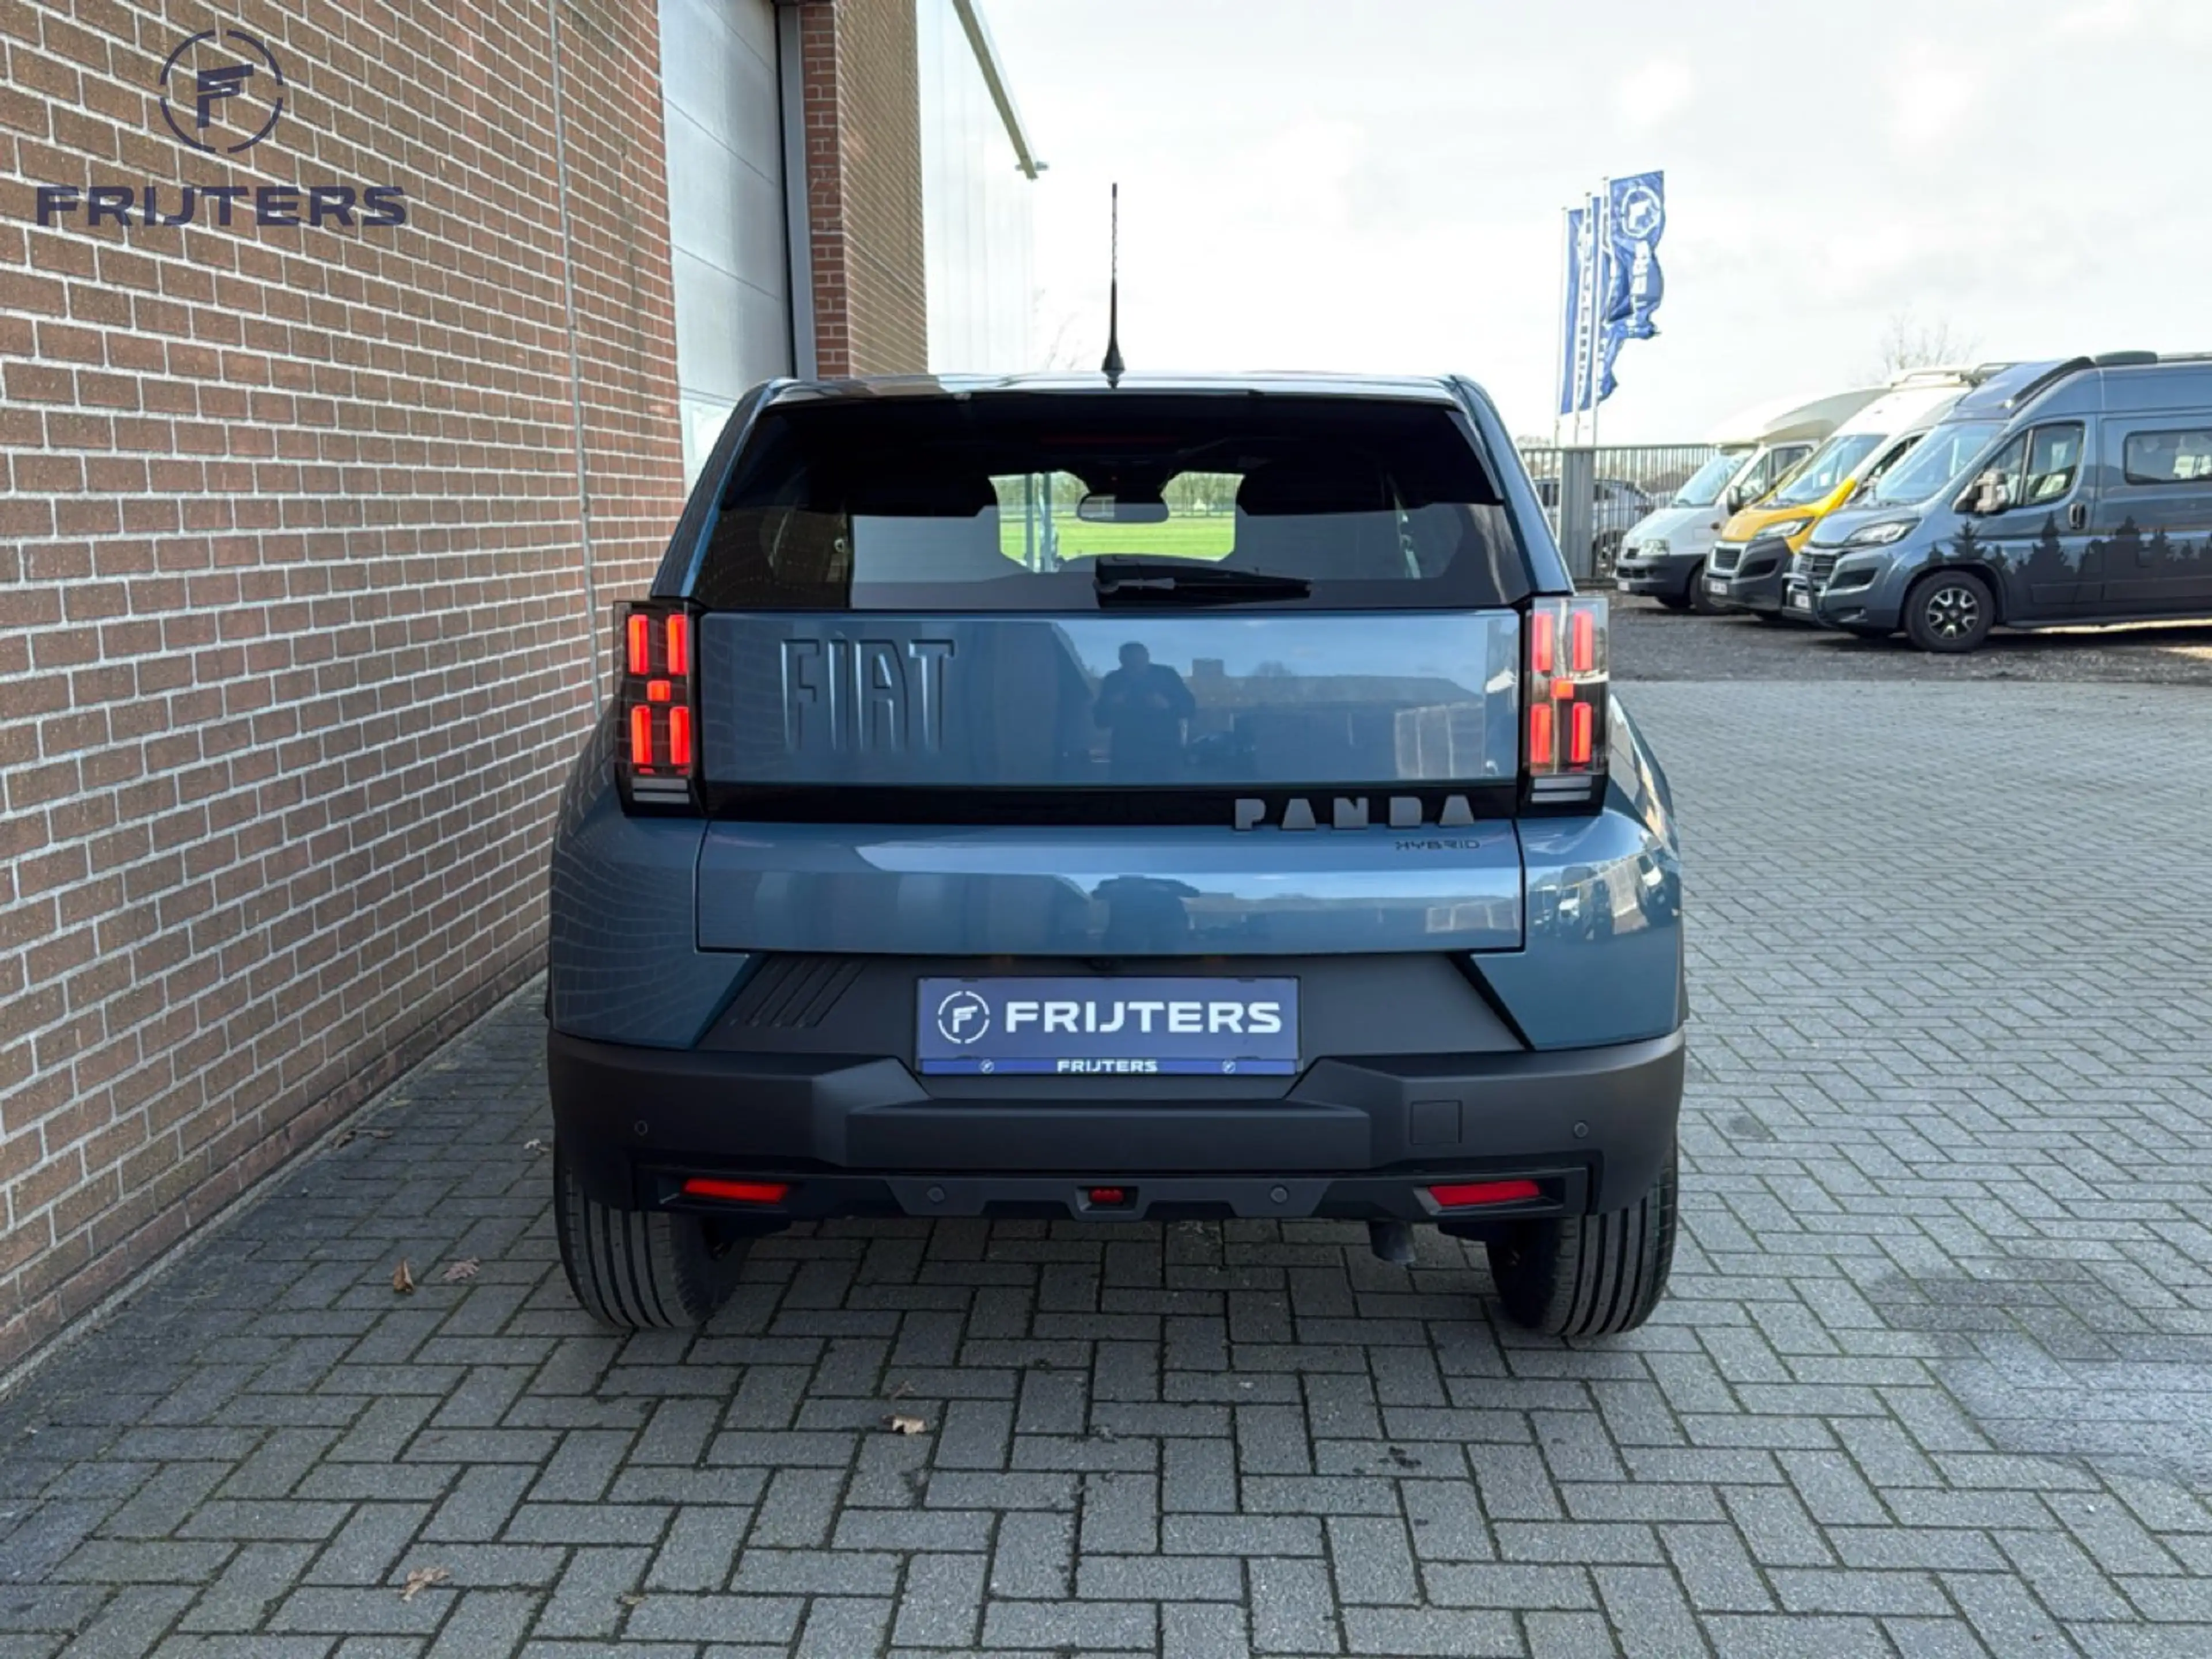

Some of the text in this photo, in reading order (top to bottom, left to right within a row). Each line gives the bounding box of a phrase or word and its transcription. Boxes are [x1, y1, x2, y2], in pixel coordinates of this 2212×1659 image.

[780, 638, 956, 751] FIAT
[1234, 796, 1475, 830] PANDA
[1395, 839, 1480, 850] HYBRID
[1005, 1002, 1282, 1033] FRIJTERS
[1056, 1059, 1158, 1073] FRIJTERS
